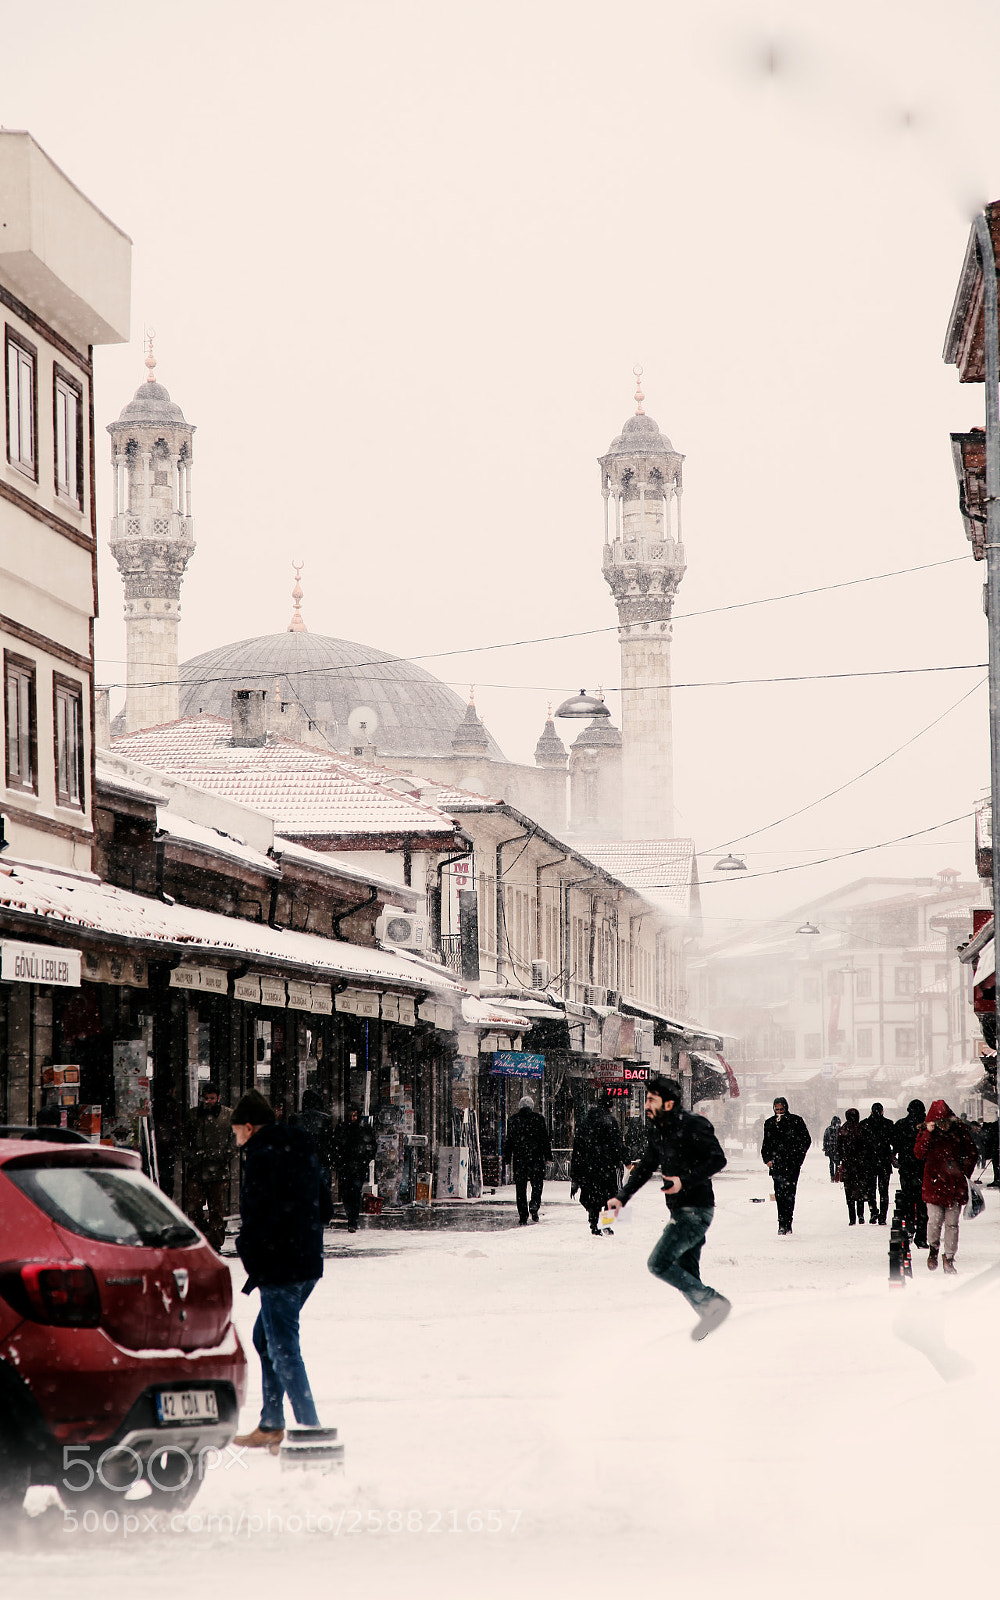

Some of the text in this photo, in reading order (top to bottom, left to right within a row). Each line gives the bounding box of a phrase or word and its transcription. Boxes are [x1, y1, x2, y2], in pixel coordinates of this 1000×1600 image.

[14, 950, 40, 980] GÖNÜL
[624, 1069, 649, 1080] BACI
[606, 1087, 629, 1096] 7/24
